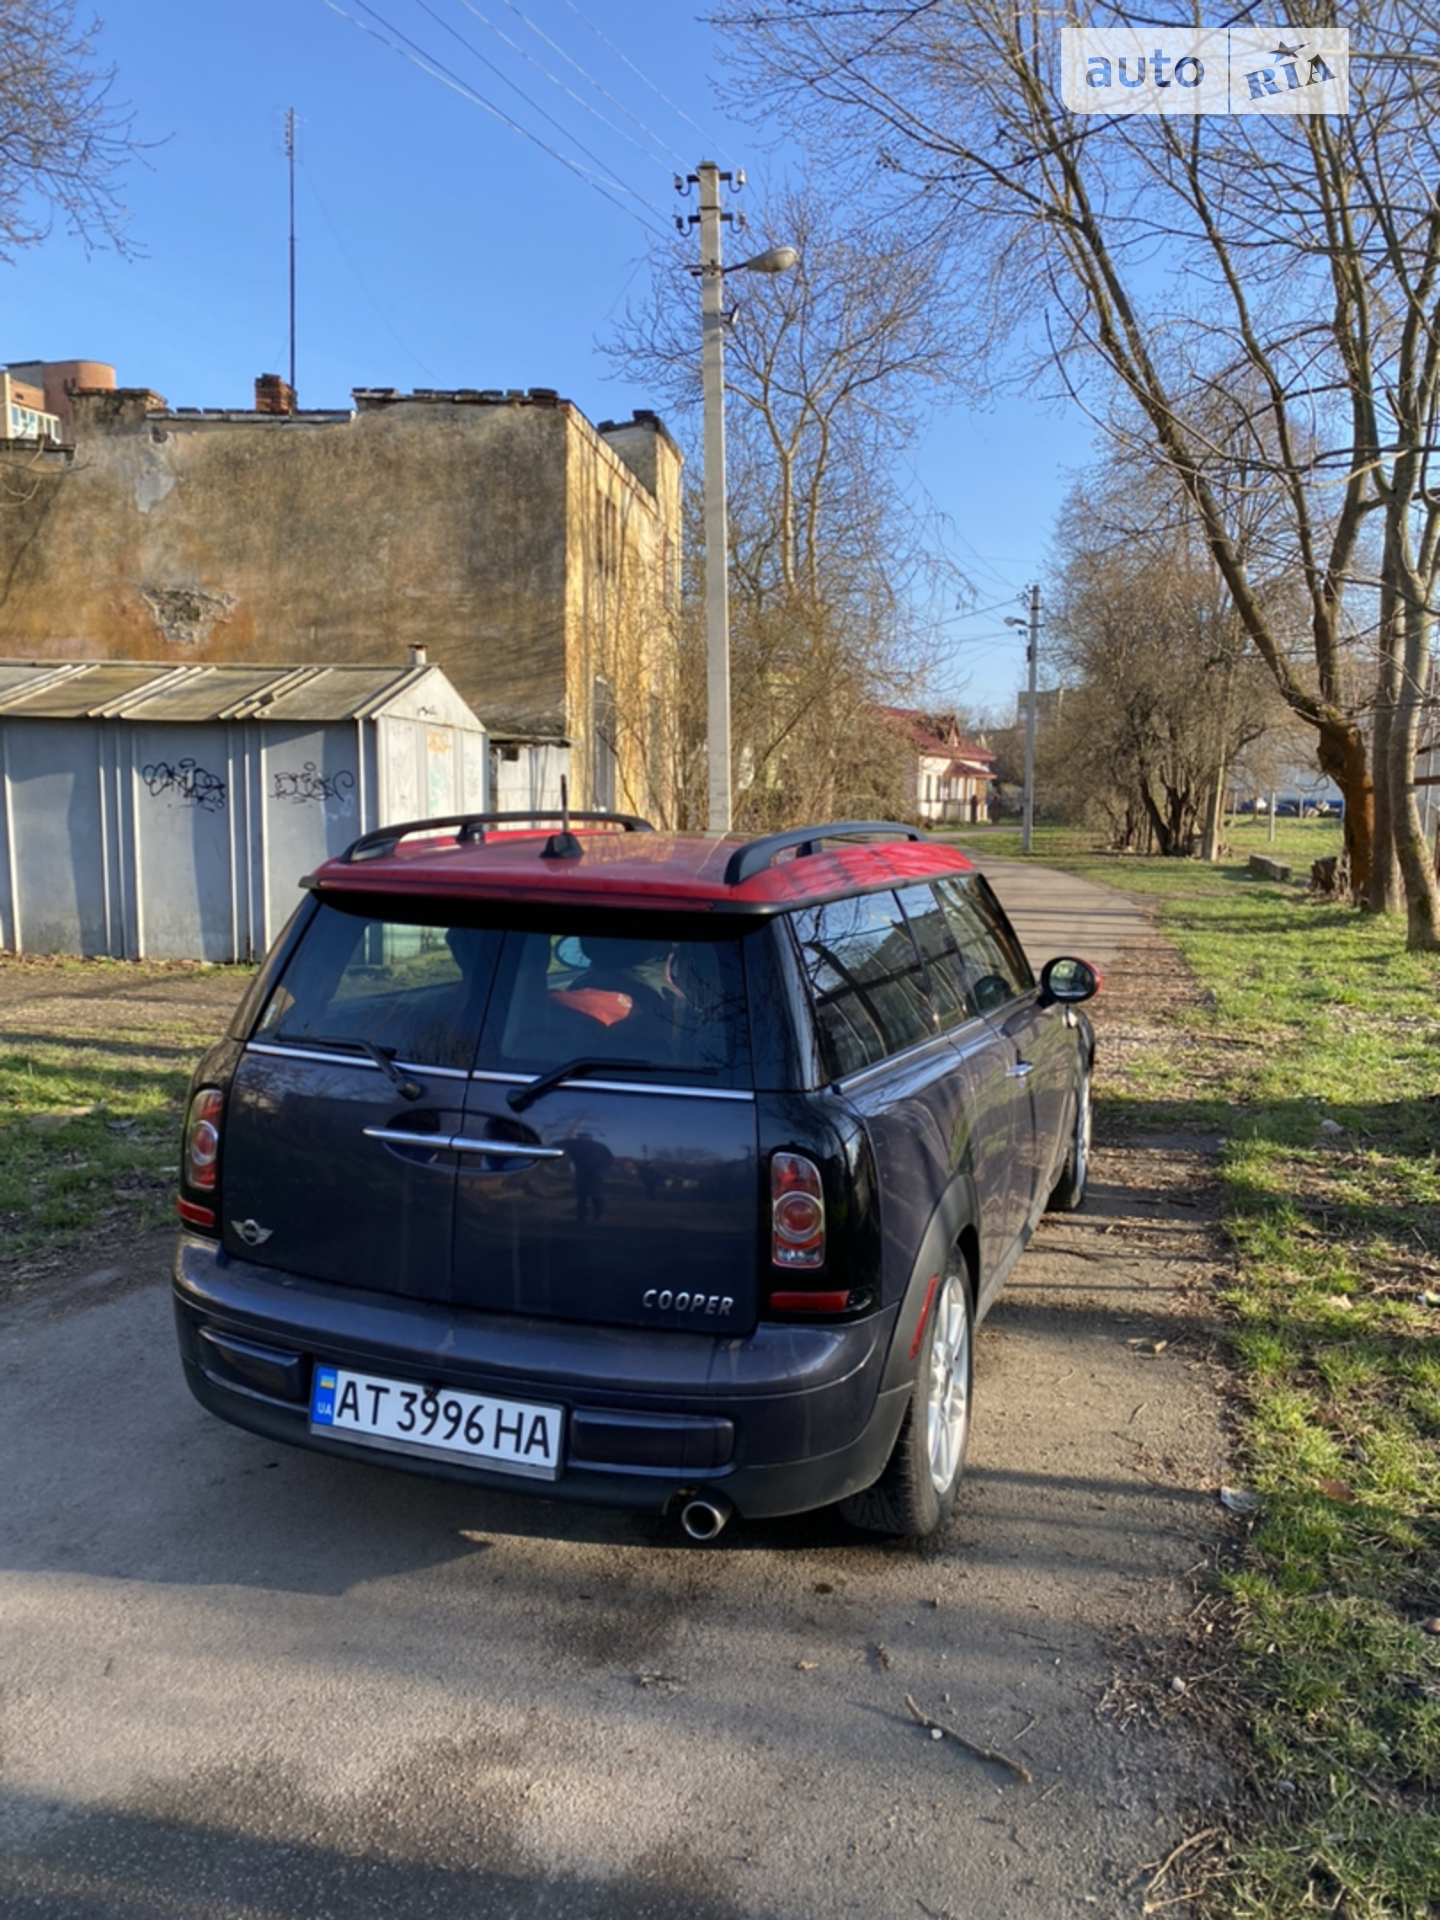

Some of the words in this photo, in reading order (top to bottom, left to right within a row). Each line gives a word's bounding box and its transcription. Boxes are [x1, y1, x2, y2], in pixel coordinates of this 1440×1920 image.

[642, 1289, 734, 1316] COOPER
[317, 1402, 332, 1416] UA
[337, 1381, 390, 1426] AT
[396, 1391, 485, 1445] 3996
